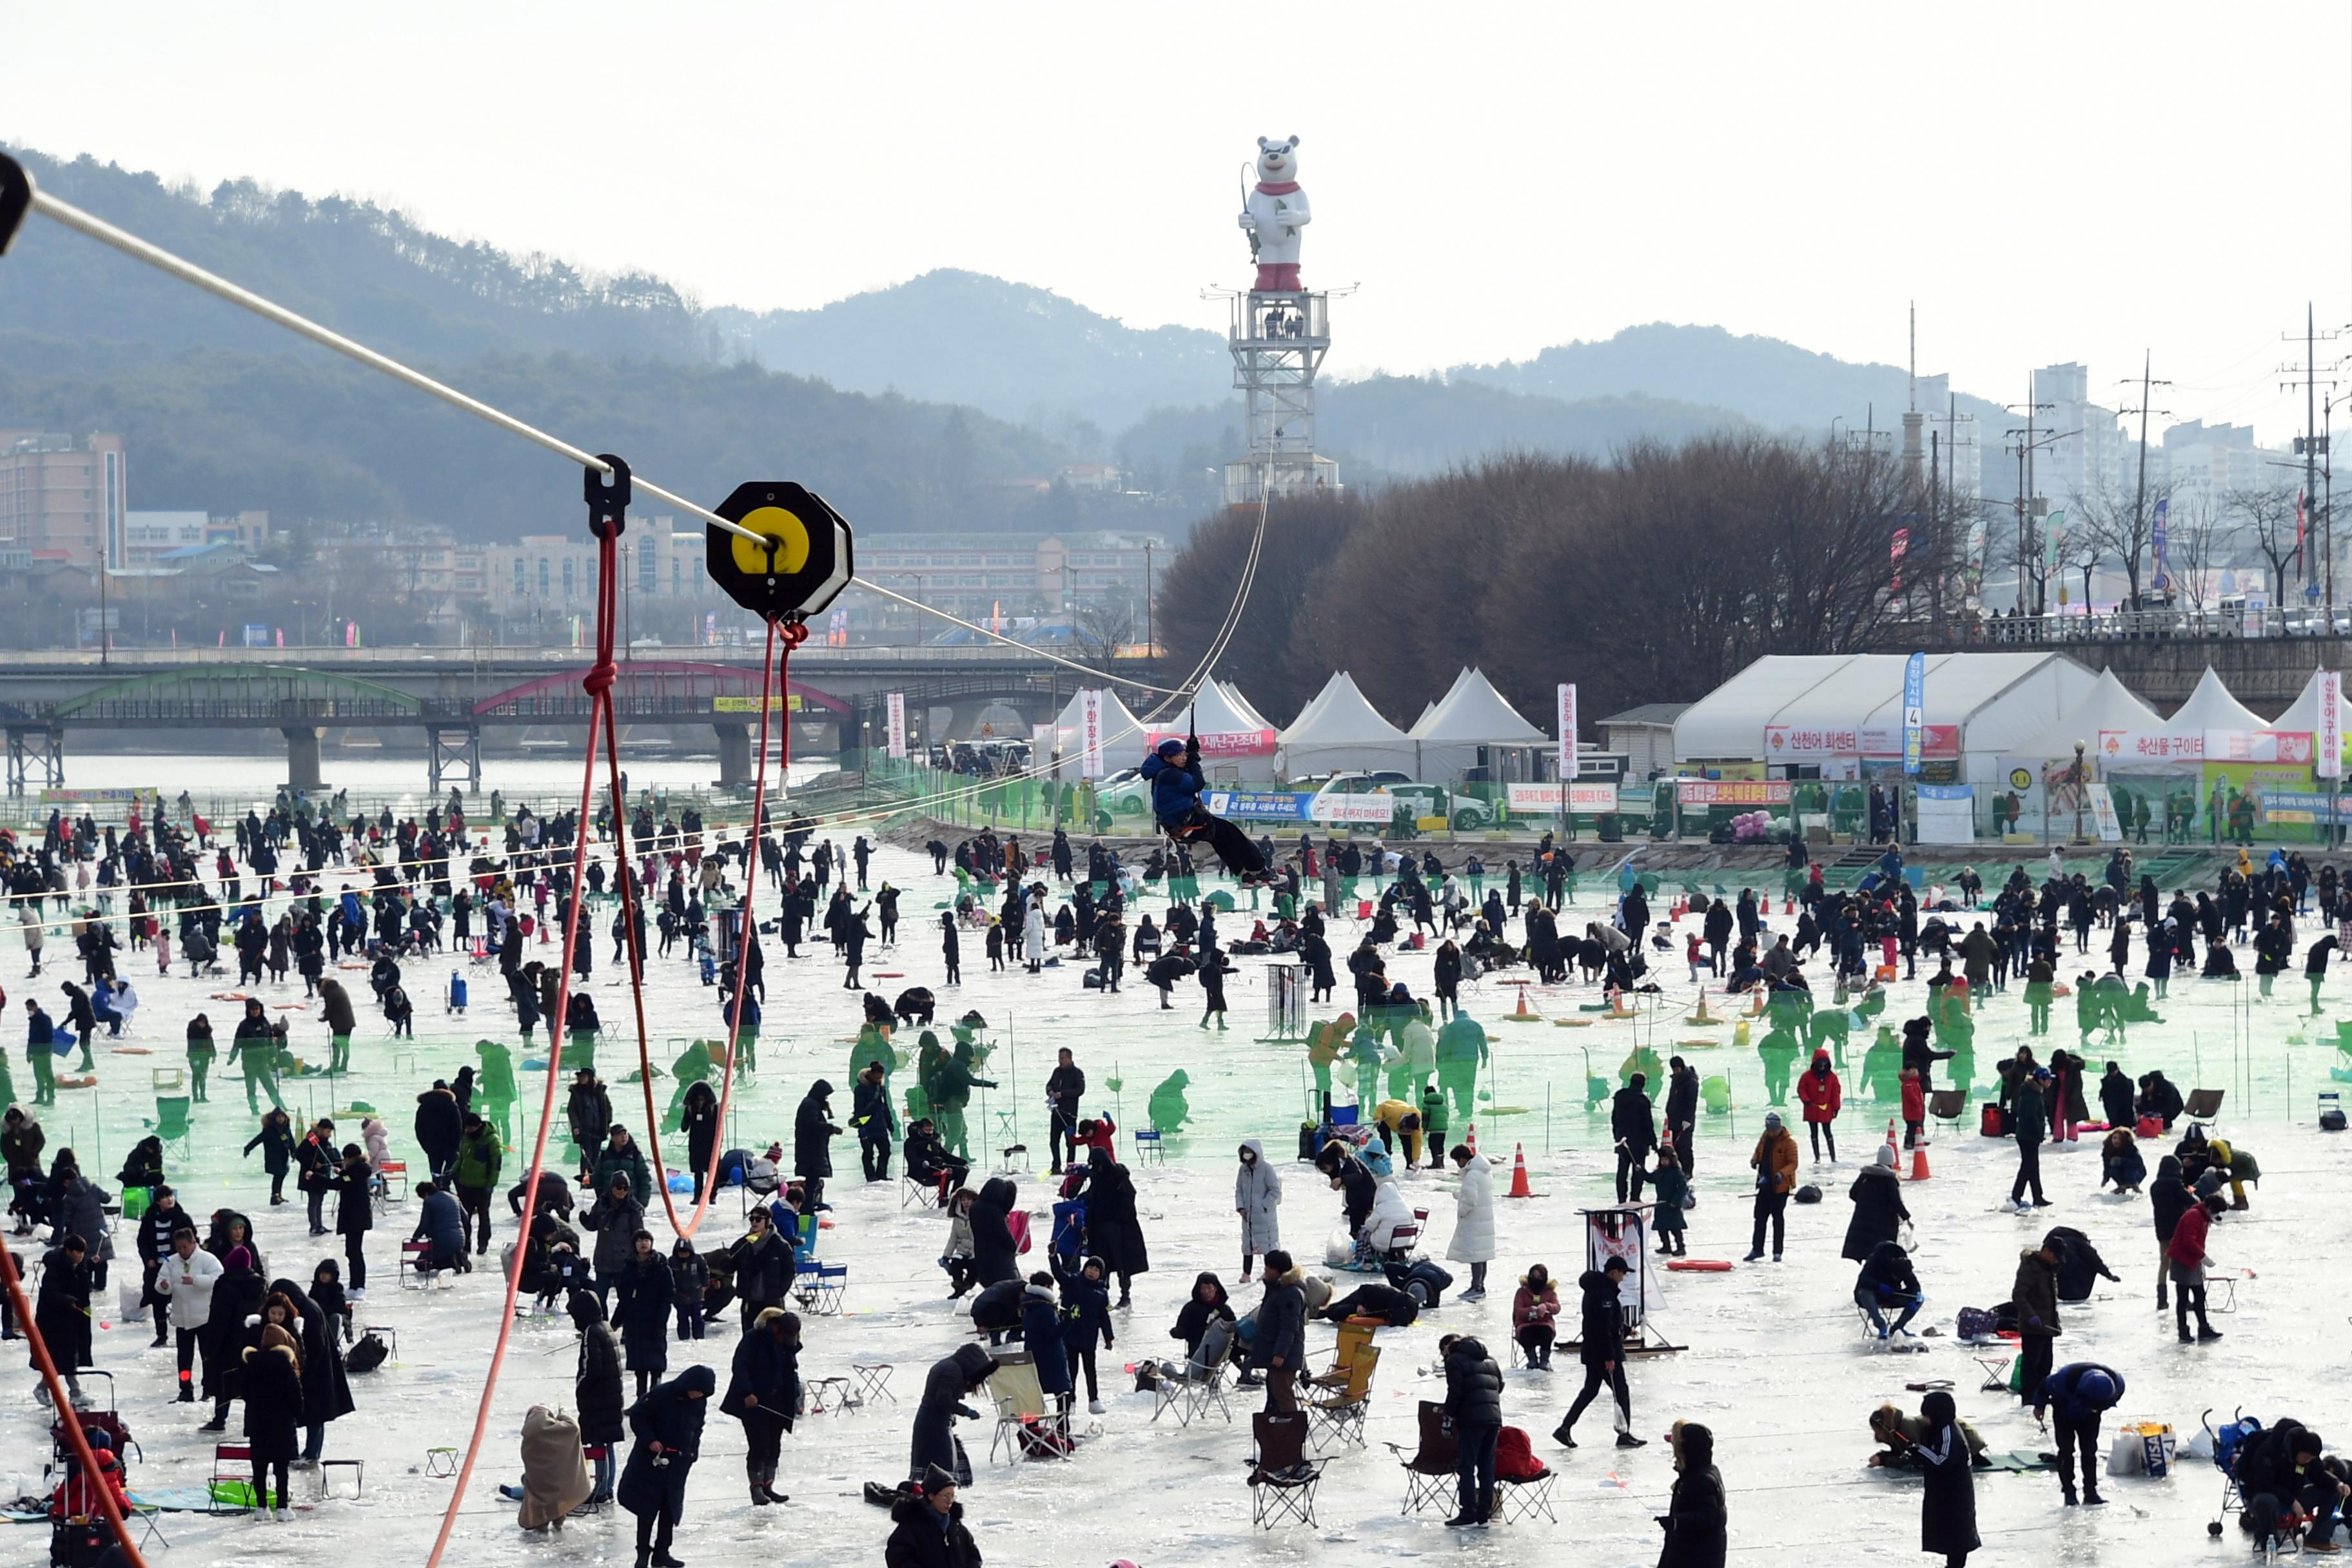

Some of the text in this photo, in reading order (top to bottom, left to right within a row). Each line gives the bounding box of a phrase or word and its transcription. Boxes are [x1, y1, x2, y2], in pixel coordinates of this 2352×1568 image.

[1563, 691, 1573, 761] 산천어 회센터
[1909, 709, 1917, 725] 4
[2324, 679, 2335, 761] 산천어구이터
[1086, 710, 1097, 752] 화장실
[1791, 731, 1821, 750] 산천어
[1825, 731, 1856, 750] 회센터
[1203, 734, 1262, 749] 재난구조대
[2137, 736, 2204, 756] 축산물 구이터
[1364, 808, 1389, 819] 마세요!
[2148, 1435, 2163, 1467] VISA
